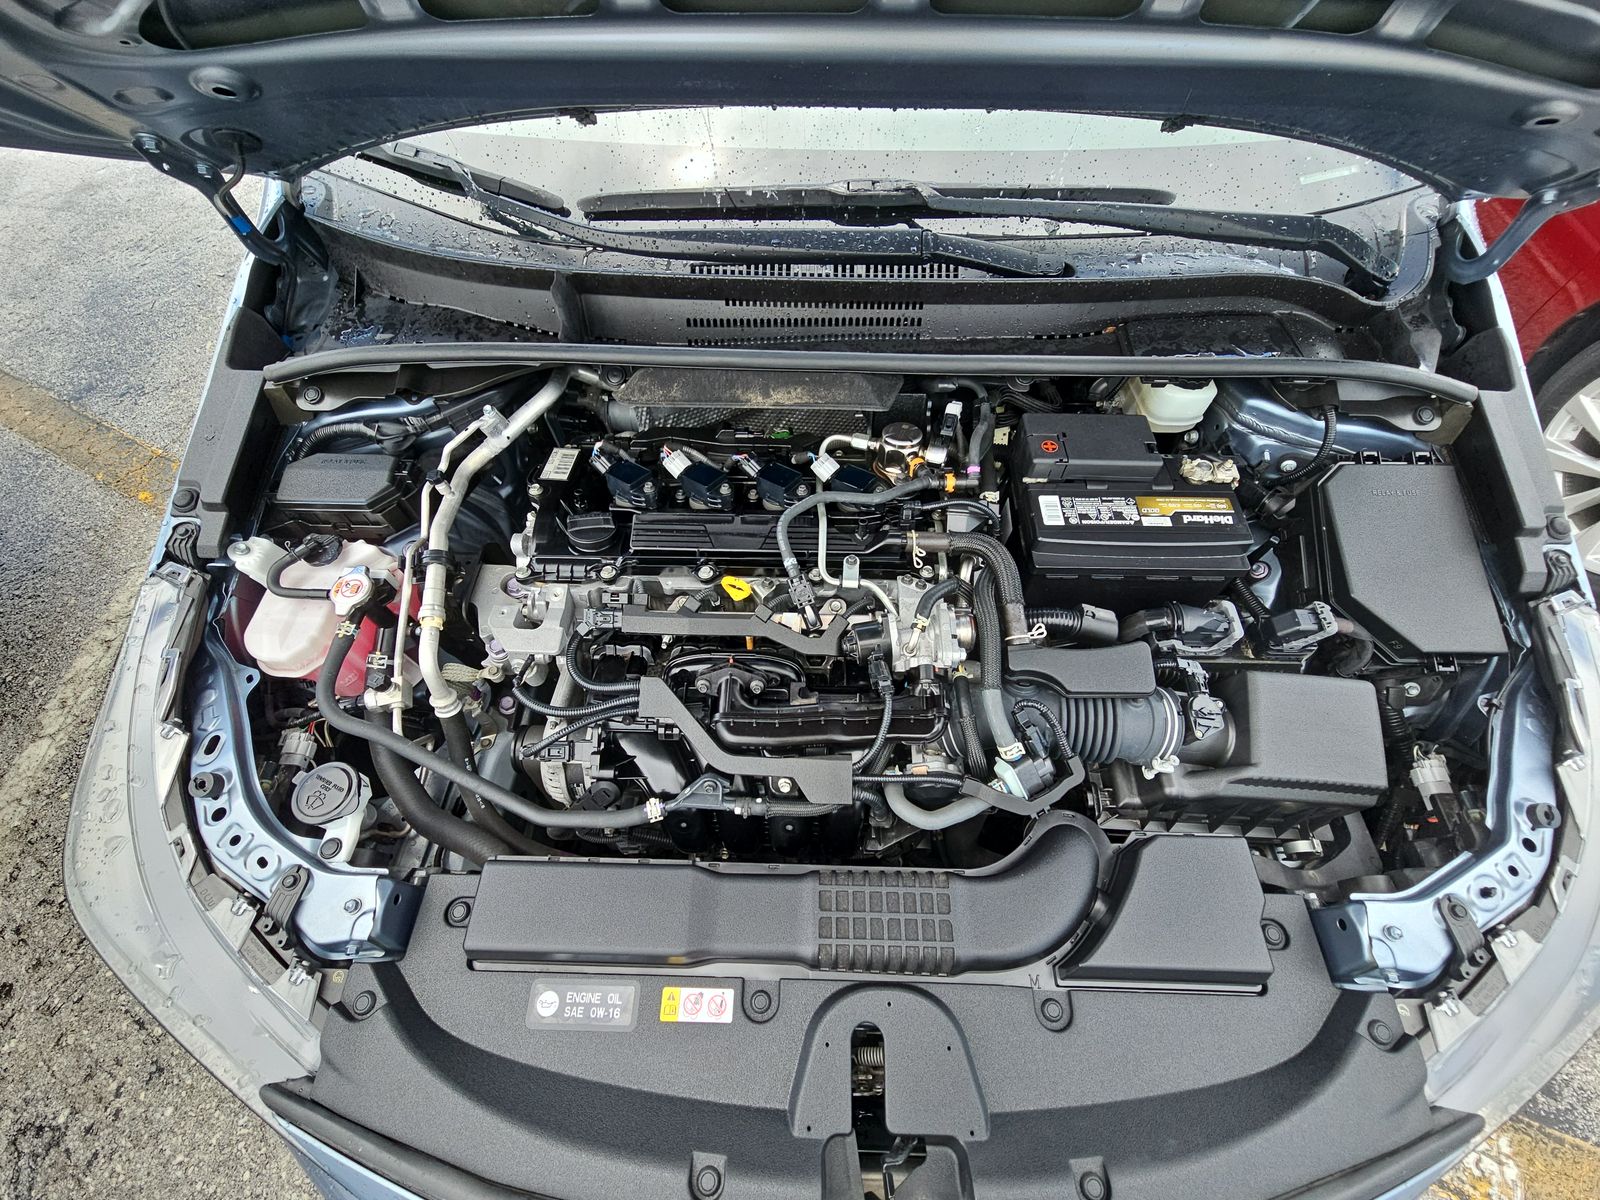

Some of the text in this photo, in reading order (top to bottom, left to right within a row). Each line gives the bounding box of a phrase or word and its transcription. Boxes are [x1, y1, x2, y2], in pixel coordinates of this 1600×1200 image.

[1182, 514, 1234, 525] DieHard
[566, 991, 623, 1005] ENGINE OIL
[564, 1007, 621, 1018] SAE 0W-16
